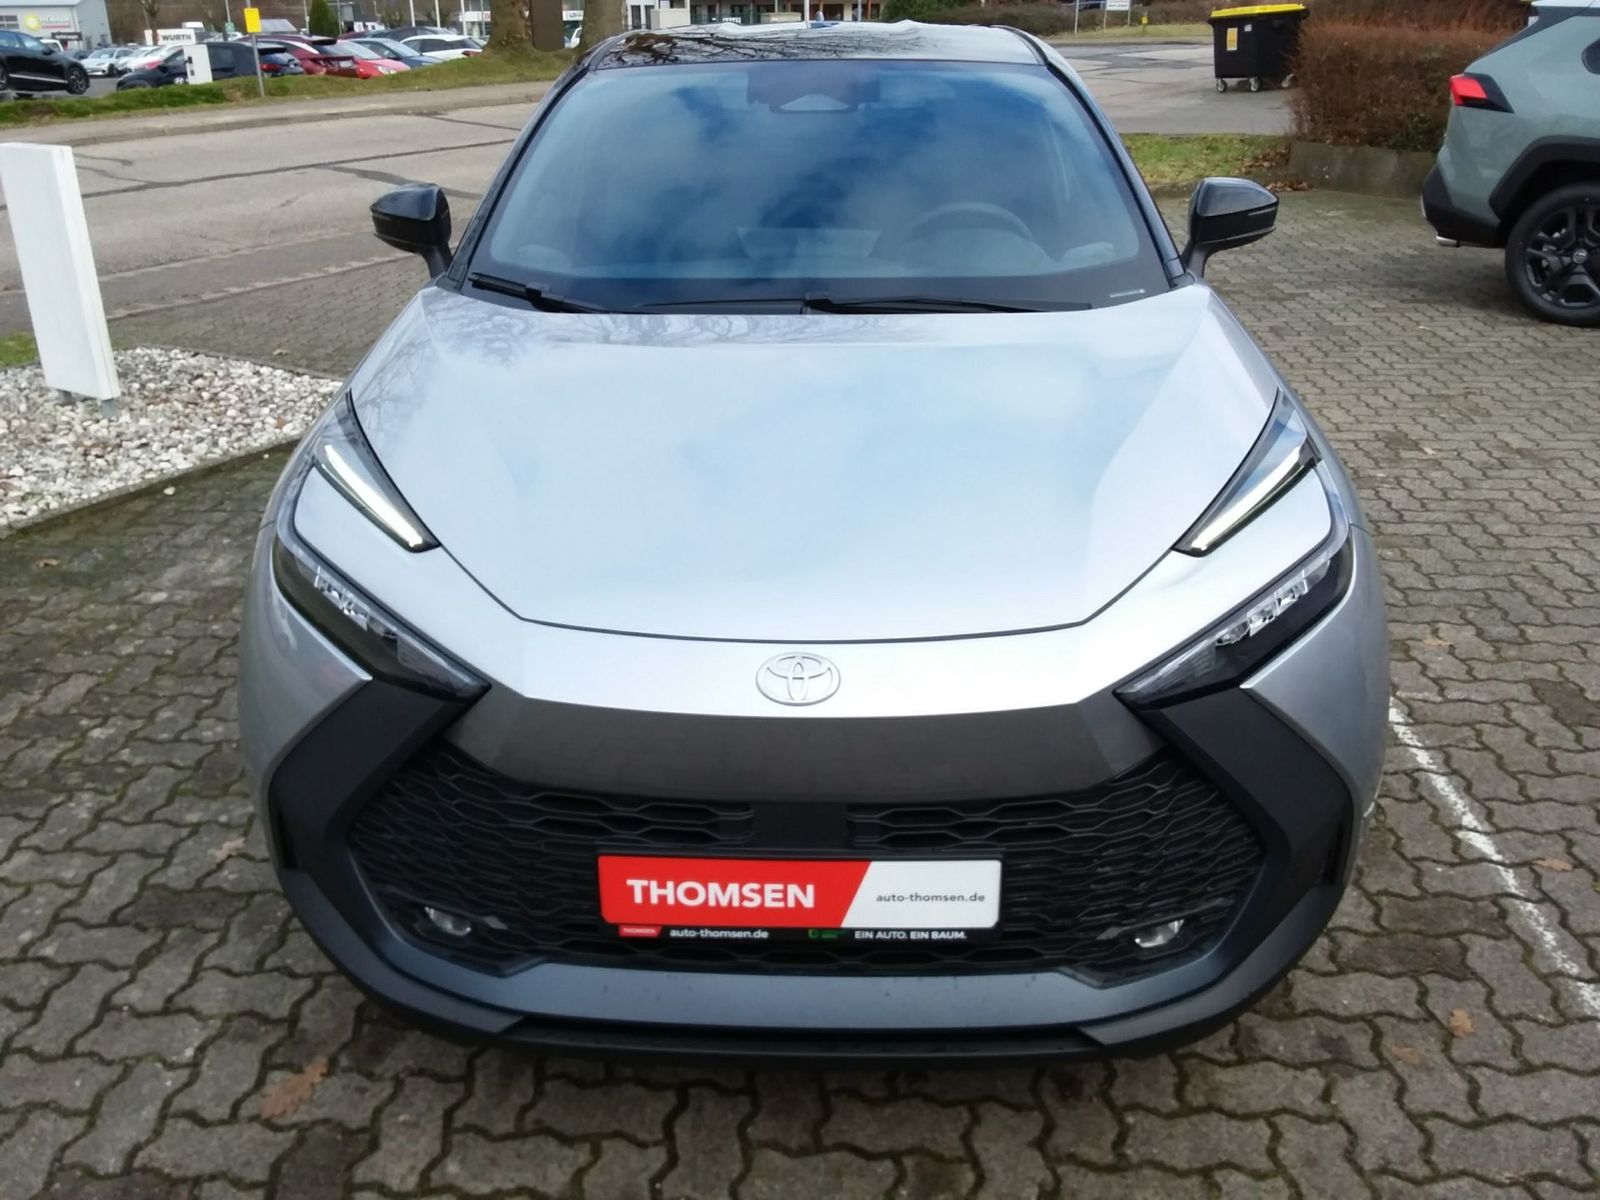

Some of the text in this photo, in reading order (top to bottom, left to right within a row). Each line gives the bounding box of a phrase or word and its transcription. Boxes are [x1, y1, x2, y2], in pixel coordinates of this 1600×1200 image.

[626, 879, 815, 908] THOMSEN
[876, 892, 986, 902] auto-thomsen.de
[669, 928, 769, 939] auto-thomsen.de
[854, 931, 873, 939] EIN
[876, 931, 908, 939] AUTO.
[910, 931, 929, 939] EIN
[931, 931, 967, 940] BAUM.
